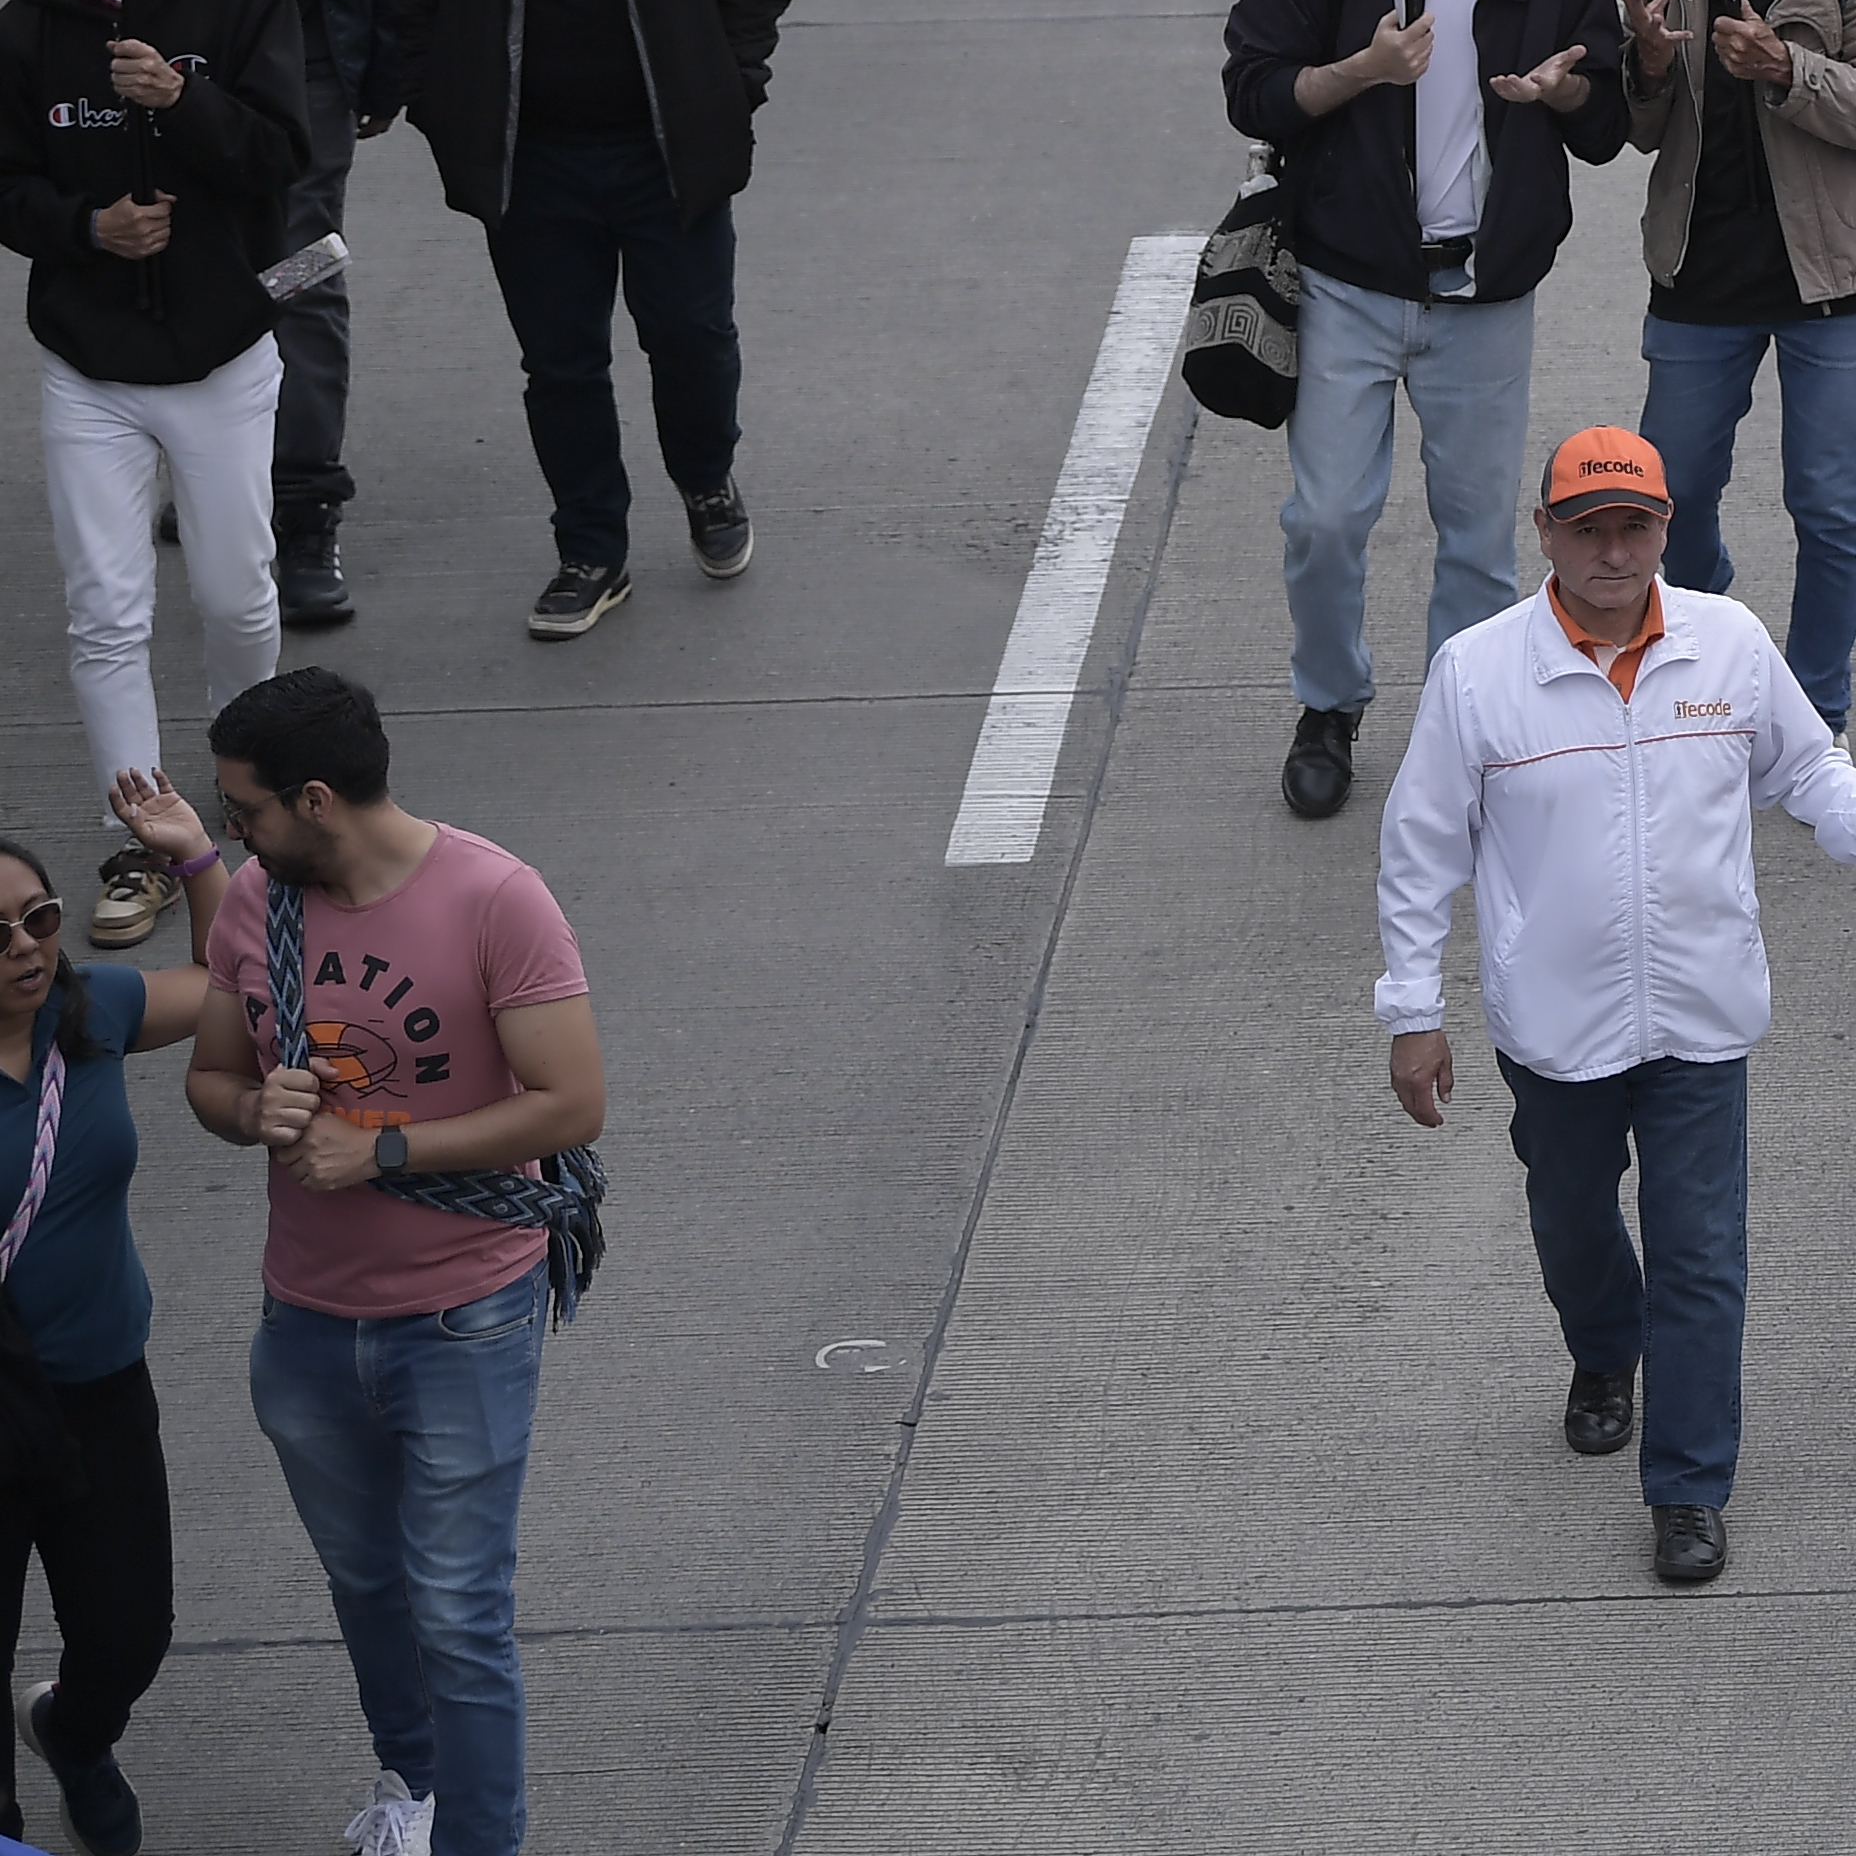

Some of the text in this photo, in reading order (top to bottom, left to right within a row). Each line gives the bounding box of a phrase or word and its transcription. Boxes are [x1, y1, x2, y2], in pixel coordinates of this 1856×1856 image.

[1586, 459, 1645, 478] fecode
[1682, 698, 1732, 718] fecode
[245, 950, 450, 1085] AATION
